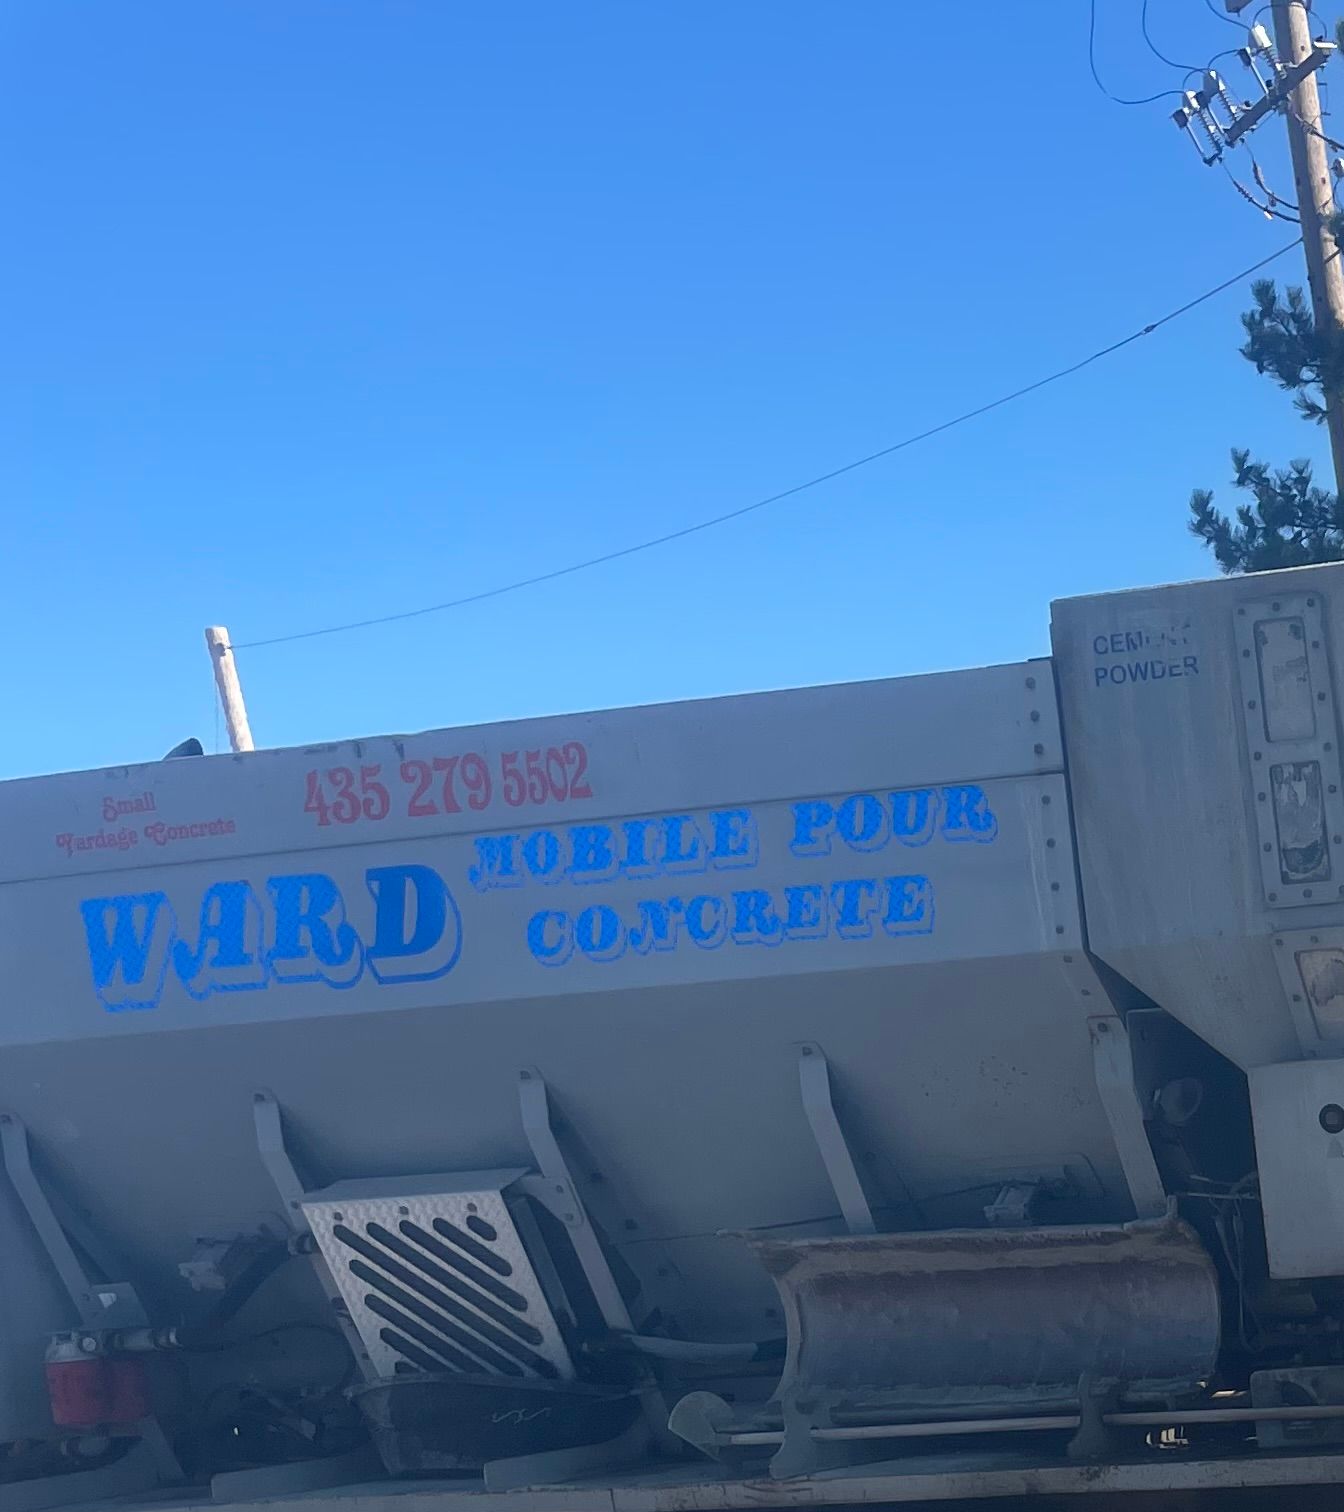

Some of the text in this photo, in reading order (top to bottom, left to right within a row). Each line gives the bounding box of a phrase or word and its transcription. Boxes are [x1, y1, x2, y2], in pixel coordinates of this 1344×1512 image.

[1094, 655, 1199, 687] POWDER
[103, 791, 157, 822] Small
[304, 741, 593, 826] 435 279 5502
[55, 818, 236, 858] Yardage Concrete
[468, 784, 998, 893] MOBILE POUR
[79, 864, 463, 1013] WARD
[527, 874, 936, 968] CONCRETE
